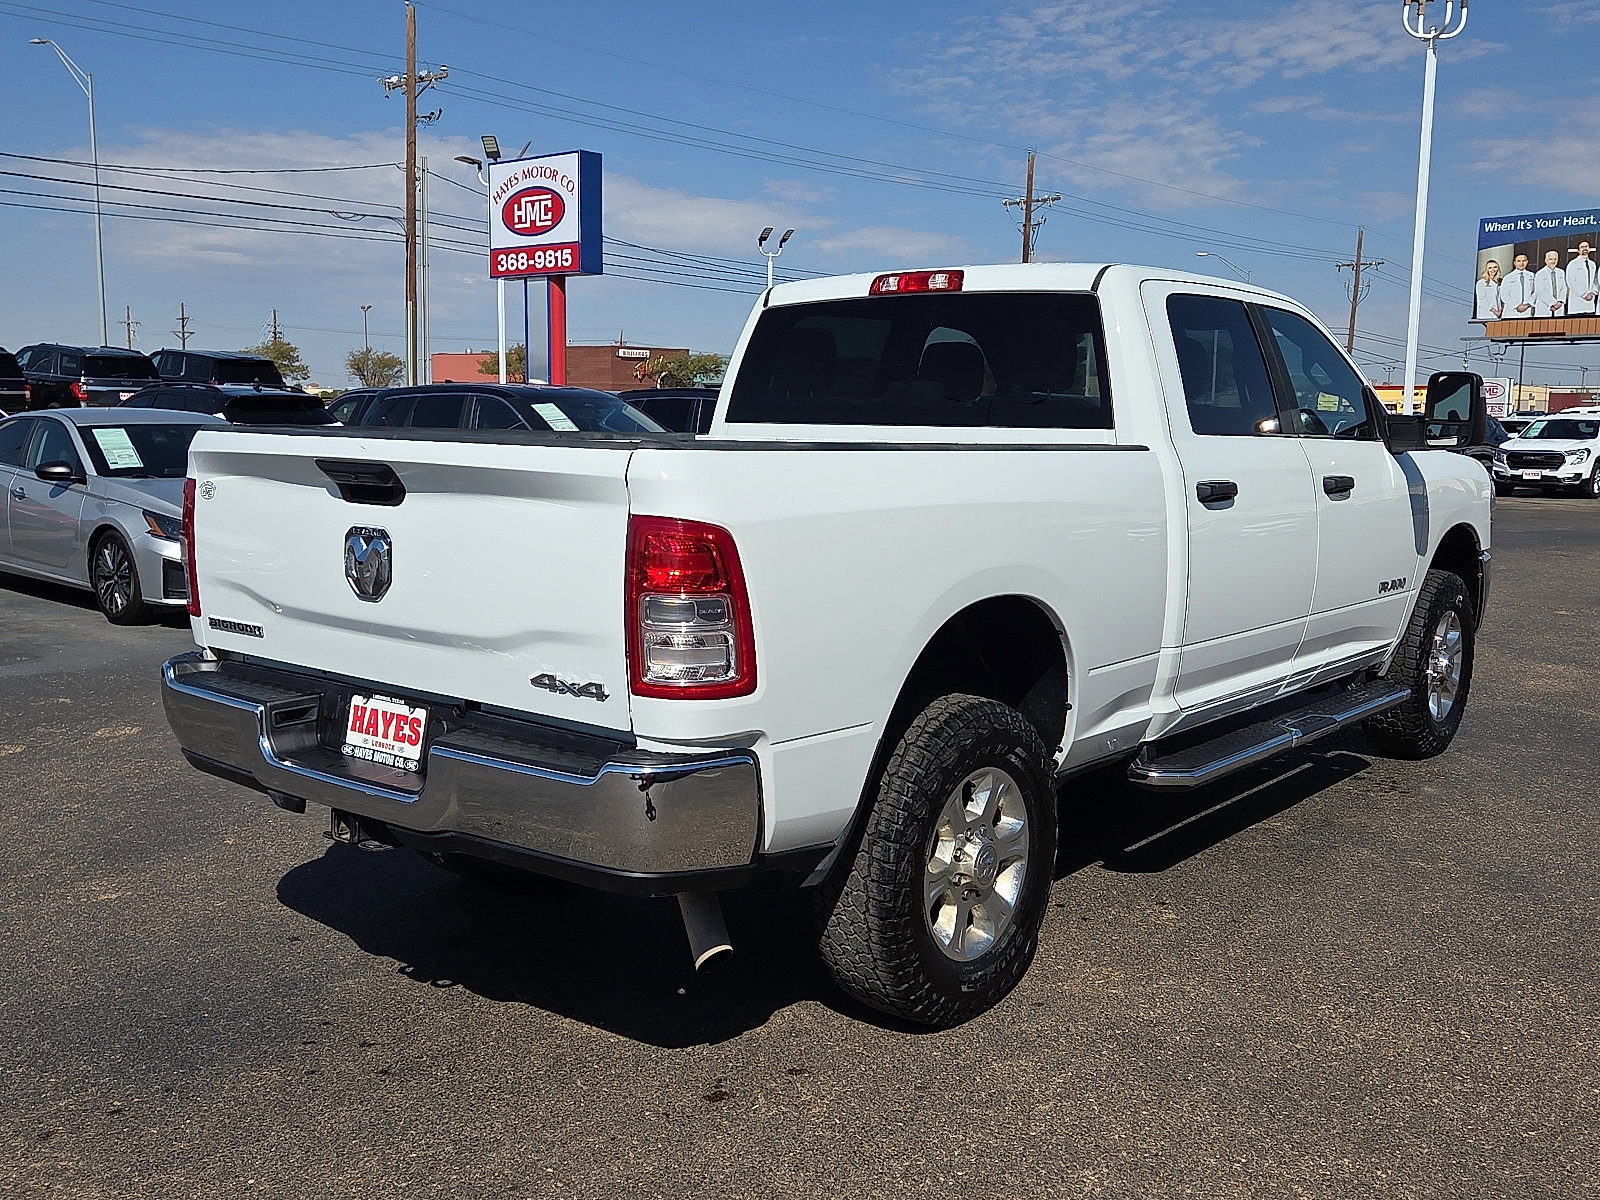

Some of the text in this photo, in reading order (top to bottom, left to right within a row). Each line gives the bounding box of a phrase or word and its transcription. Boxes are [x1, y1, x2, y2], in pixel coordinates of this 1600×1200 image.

[492, 166, 575, 205] HAYES MOTOR CO.
[513, 194, 552, 229] HMC
[1484, 221, 1515, 233] When
[1517, 219, 1533, 230] It's
[1535, 218, 1561, 229] Your
[497, 248, 572, 272] 368-9815
[1378, 577, 1407, 594] RAM
[350, 704, 421, 746] HAYES
[354, 746, 373, 760] HAYES
[373, 750, 394, 766] MOTOR
